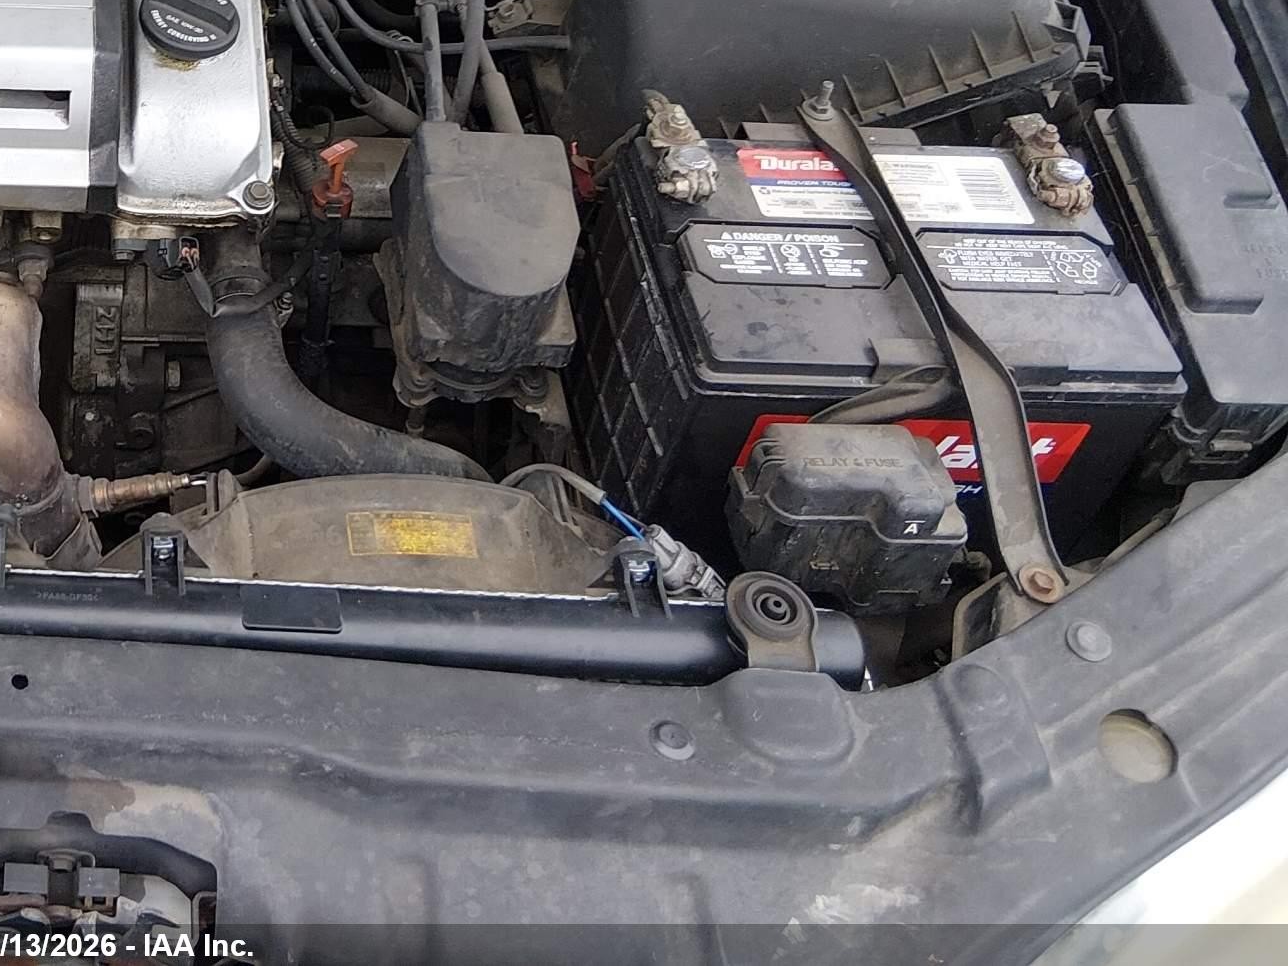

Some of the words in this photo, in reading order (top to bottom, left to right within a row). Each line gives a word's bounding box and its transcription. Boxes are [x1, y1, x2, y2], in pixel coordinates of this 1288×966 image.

[752, 155, 841, 172] Durala
[733, 232, 783, 242] DANGER
[793, 233, 840, 243] POISON
[803, 456, 848, 467] RELAY
[863, 457, 903, 468] FUSE
